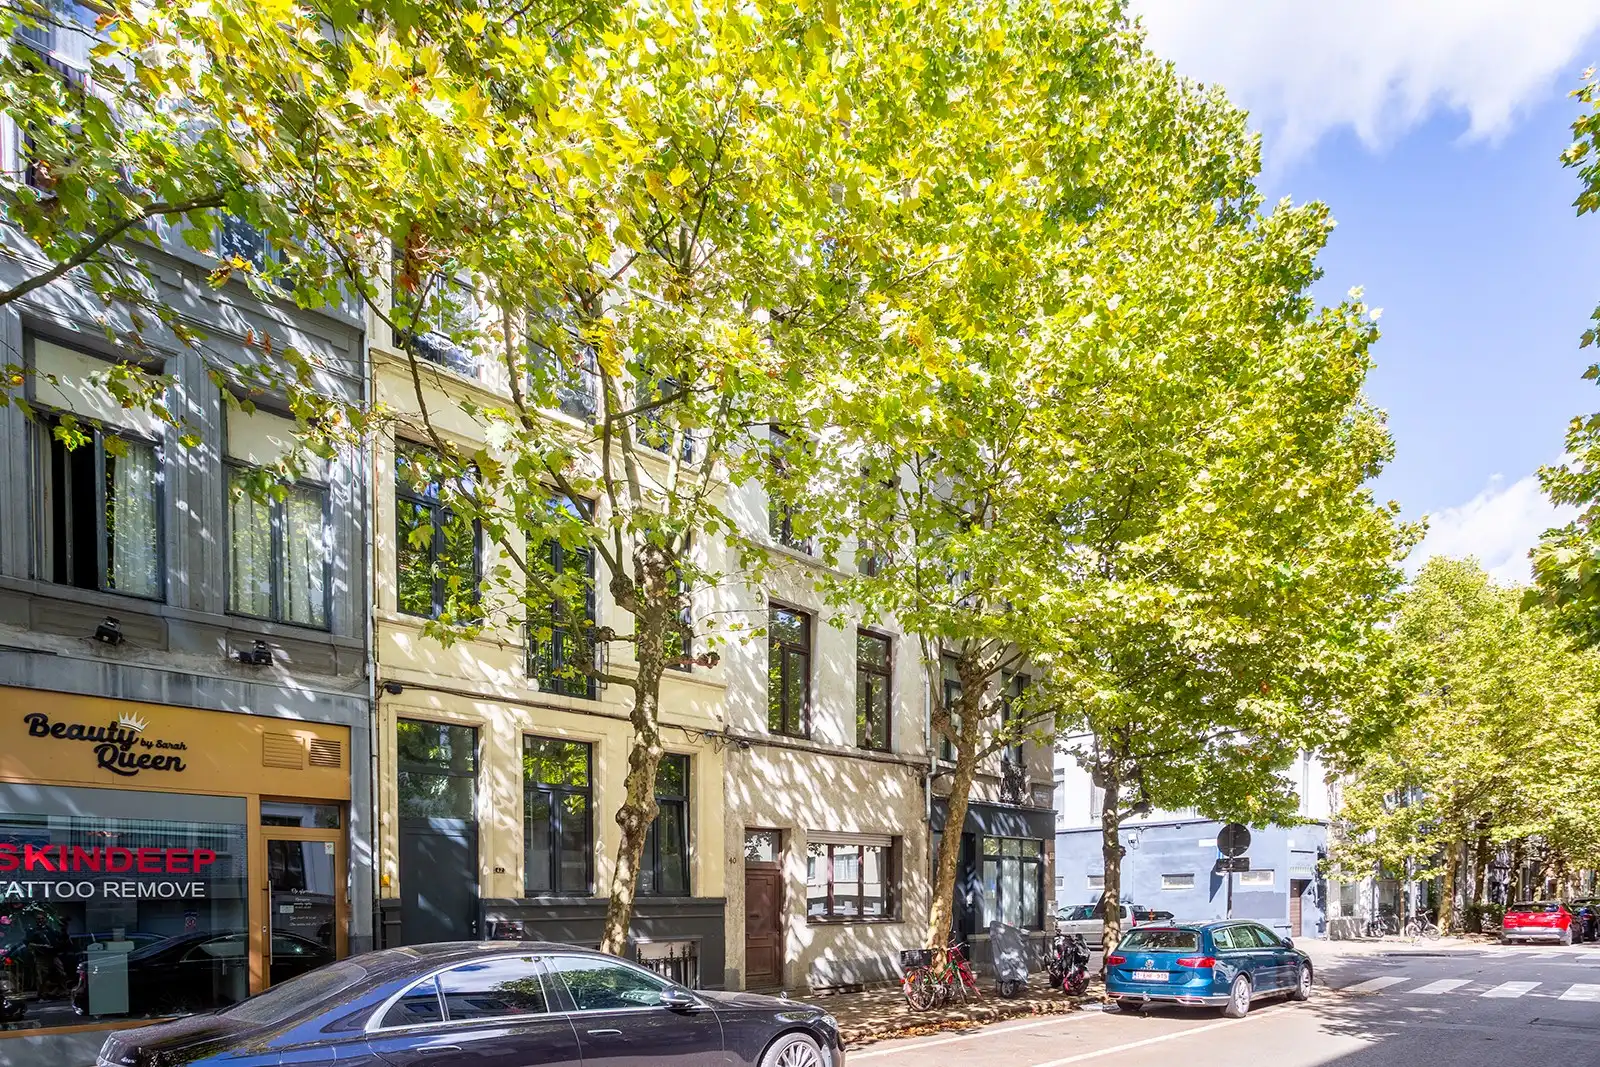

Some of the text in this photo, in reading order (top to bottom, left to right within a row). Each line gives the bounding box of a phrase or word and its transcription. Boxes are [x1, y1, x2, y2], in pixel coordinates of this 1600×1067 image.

[24, 712, 139, 751] Beauty
[140, 738, 187, 750] by Sarah
[94, 743, 186, 776] Queen
[0, 844, 217, 873] SKINDEEP
[103, 882, 206, 898] REMOVE
